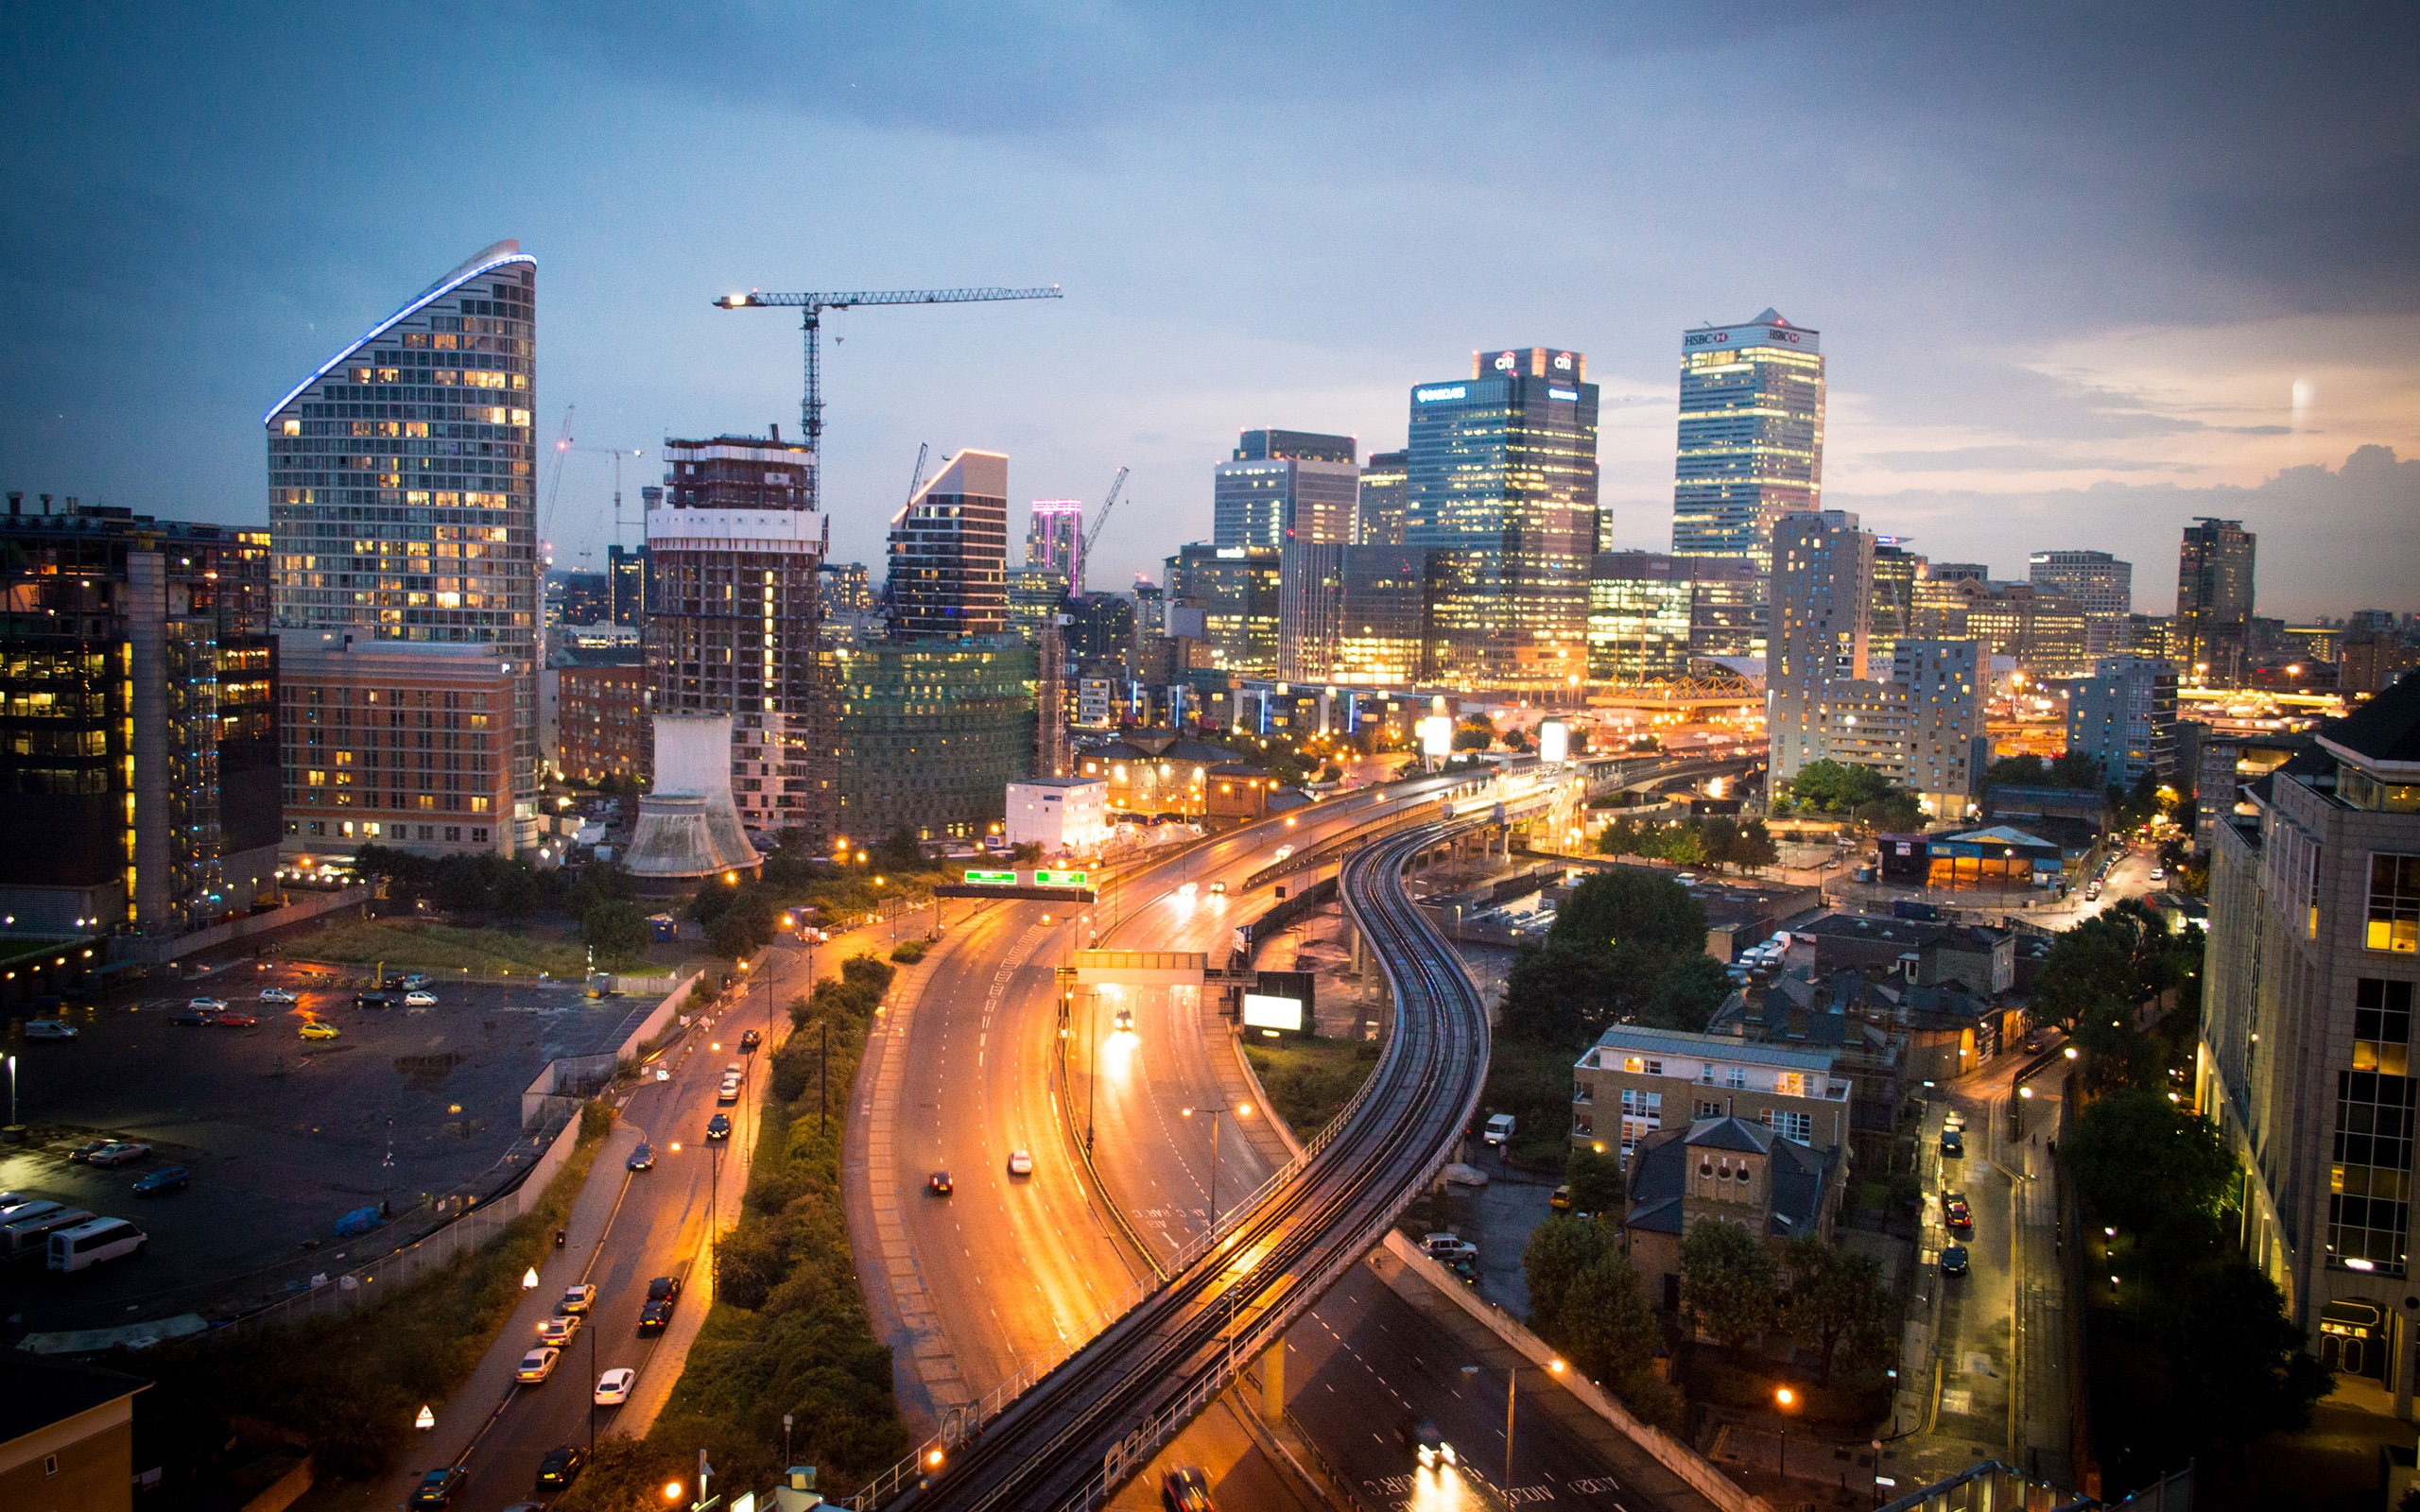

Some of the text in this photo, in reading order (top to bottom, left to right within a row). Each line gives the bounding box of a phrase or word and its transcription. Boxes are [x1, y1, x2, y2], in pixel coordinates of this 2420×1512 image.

[1685, 333, 1713, 346] HSBC
[1769, 329, 1789, 341] HSBC
[1495, 353, 1515, 369] citi
[1553, 353, 1572, 370] citi
